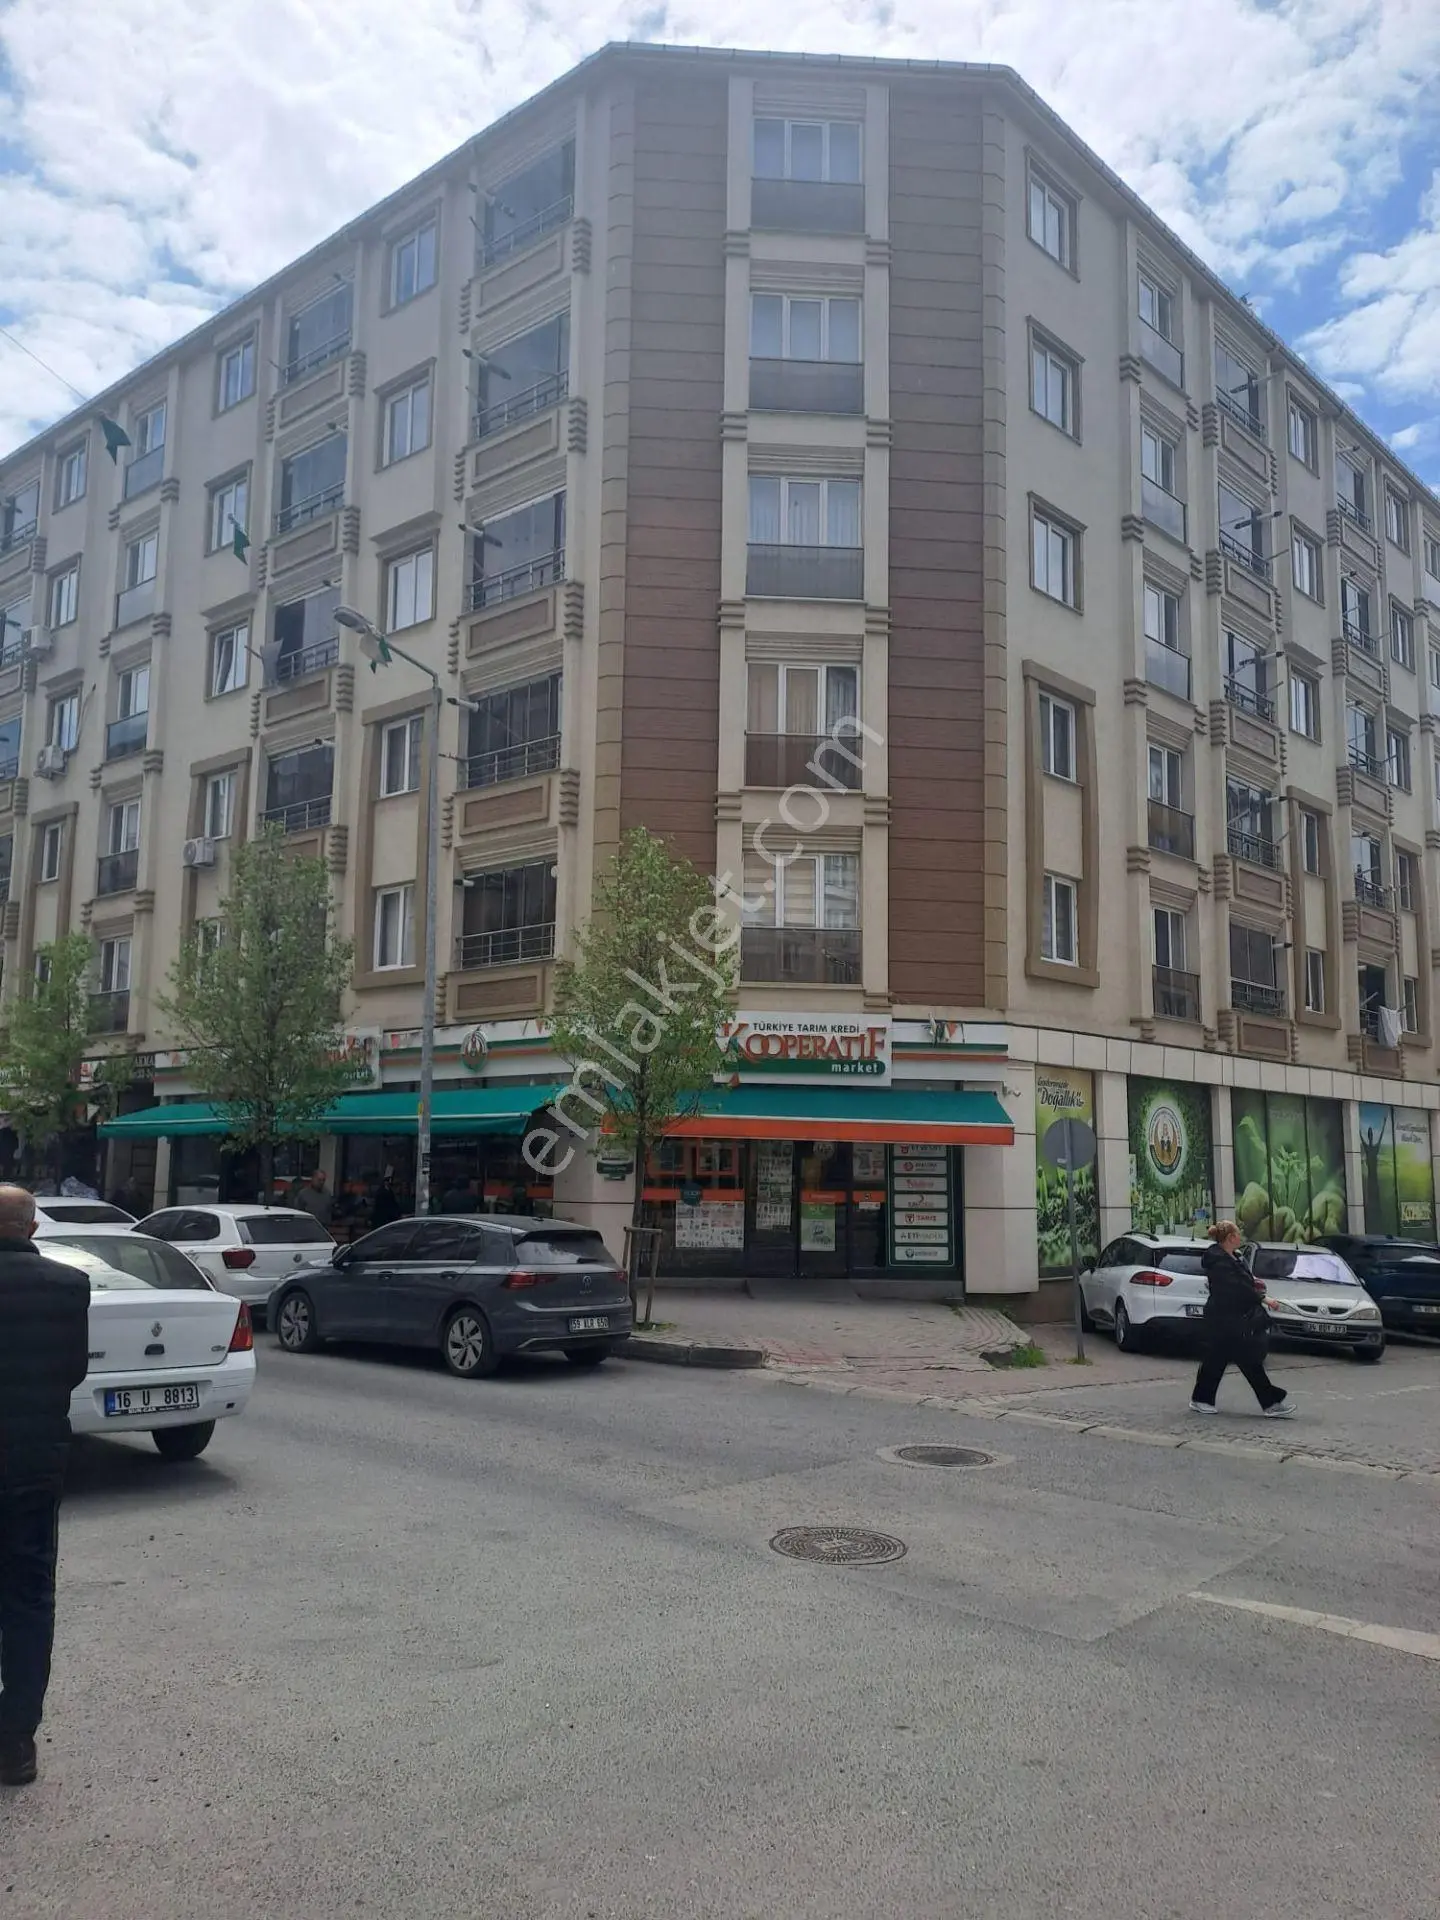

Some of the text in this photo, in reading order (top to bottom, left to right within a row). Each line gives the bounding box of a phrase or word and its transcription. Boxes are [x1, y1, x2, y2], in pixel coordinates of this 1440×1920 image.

[753, 1021, 860, 1034] TÜRKİYE TARIM KREDİ
[831, 1062, 878, 1074] market
[116, 1387, 195, 1408] 16 U 8813
